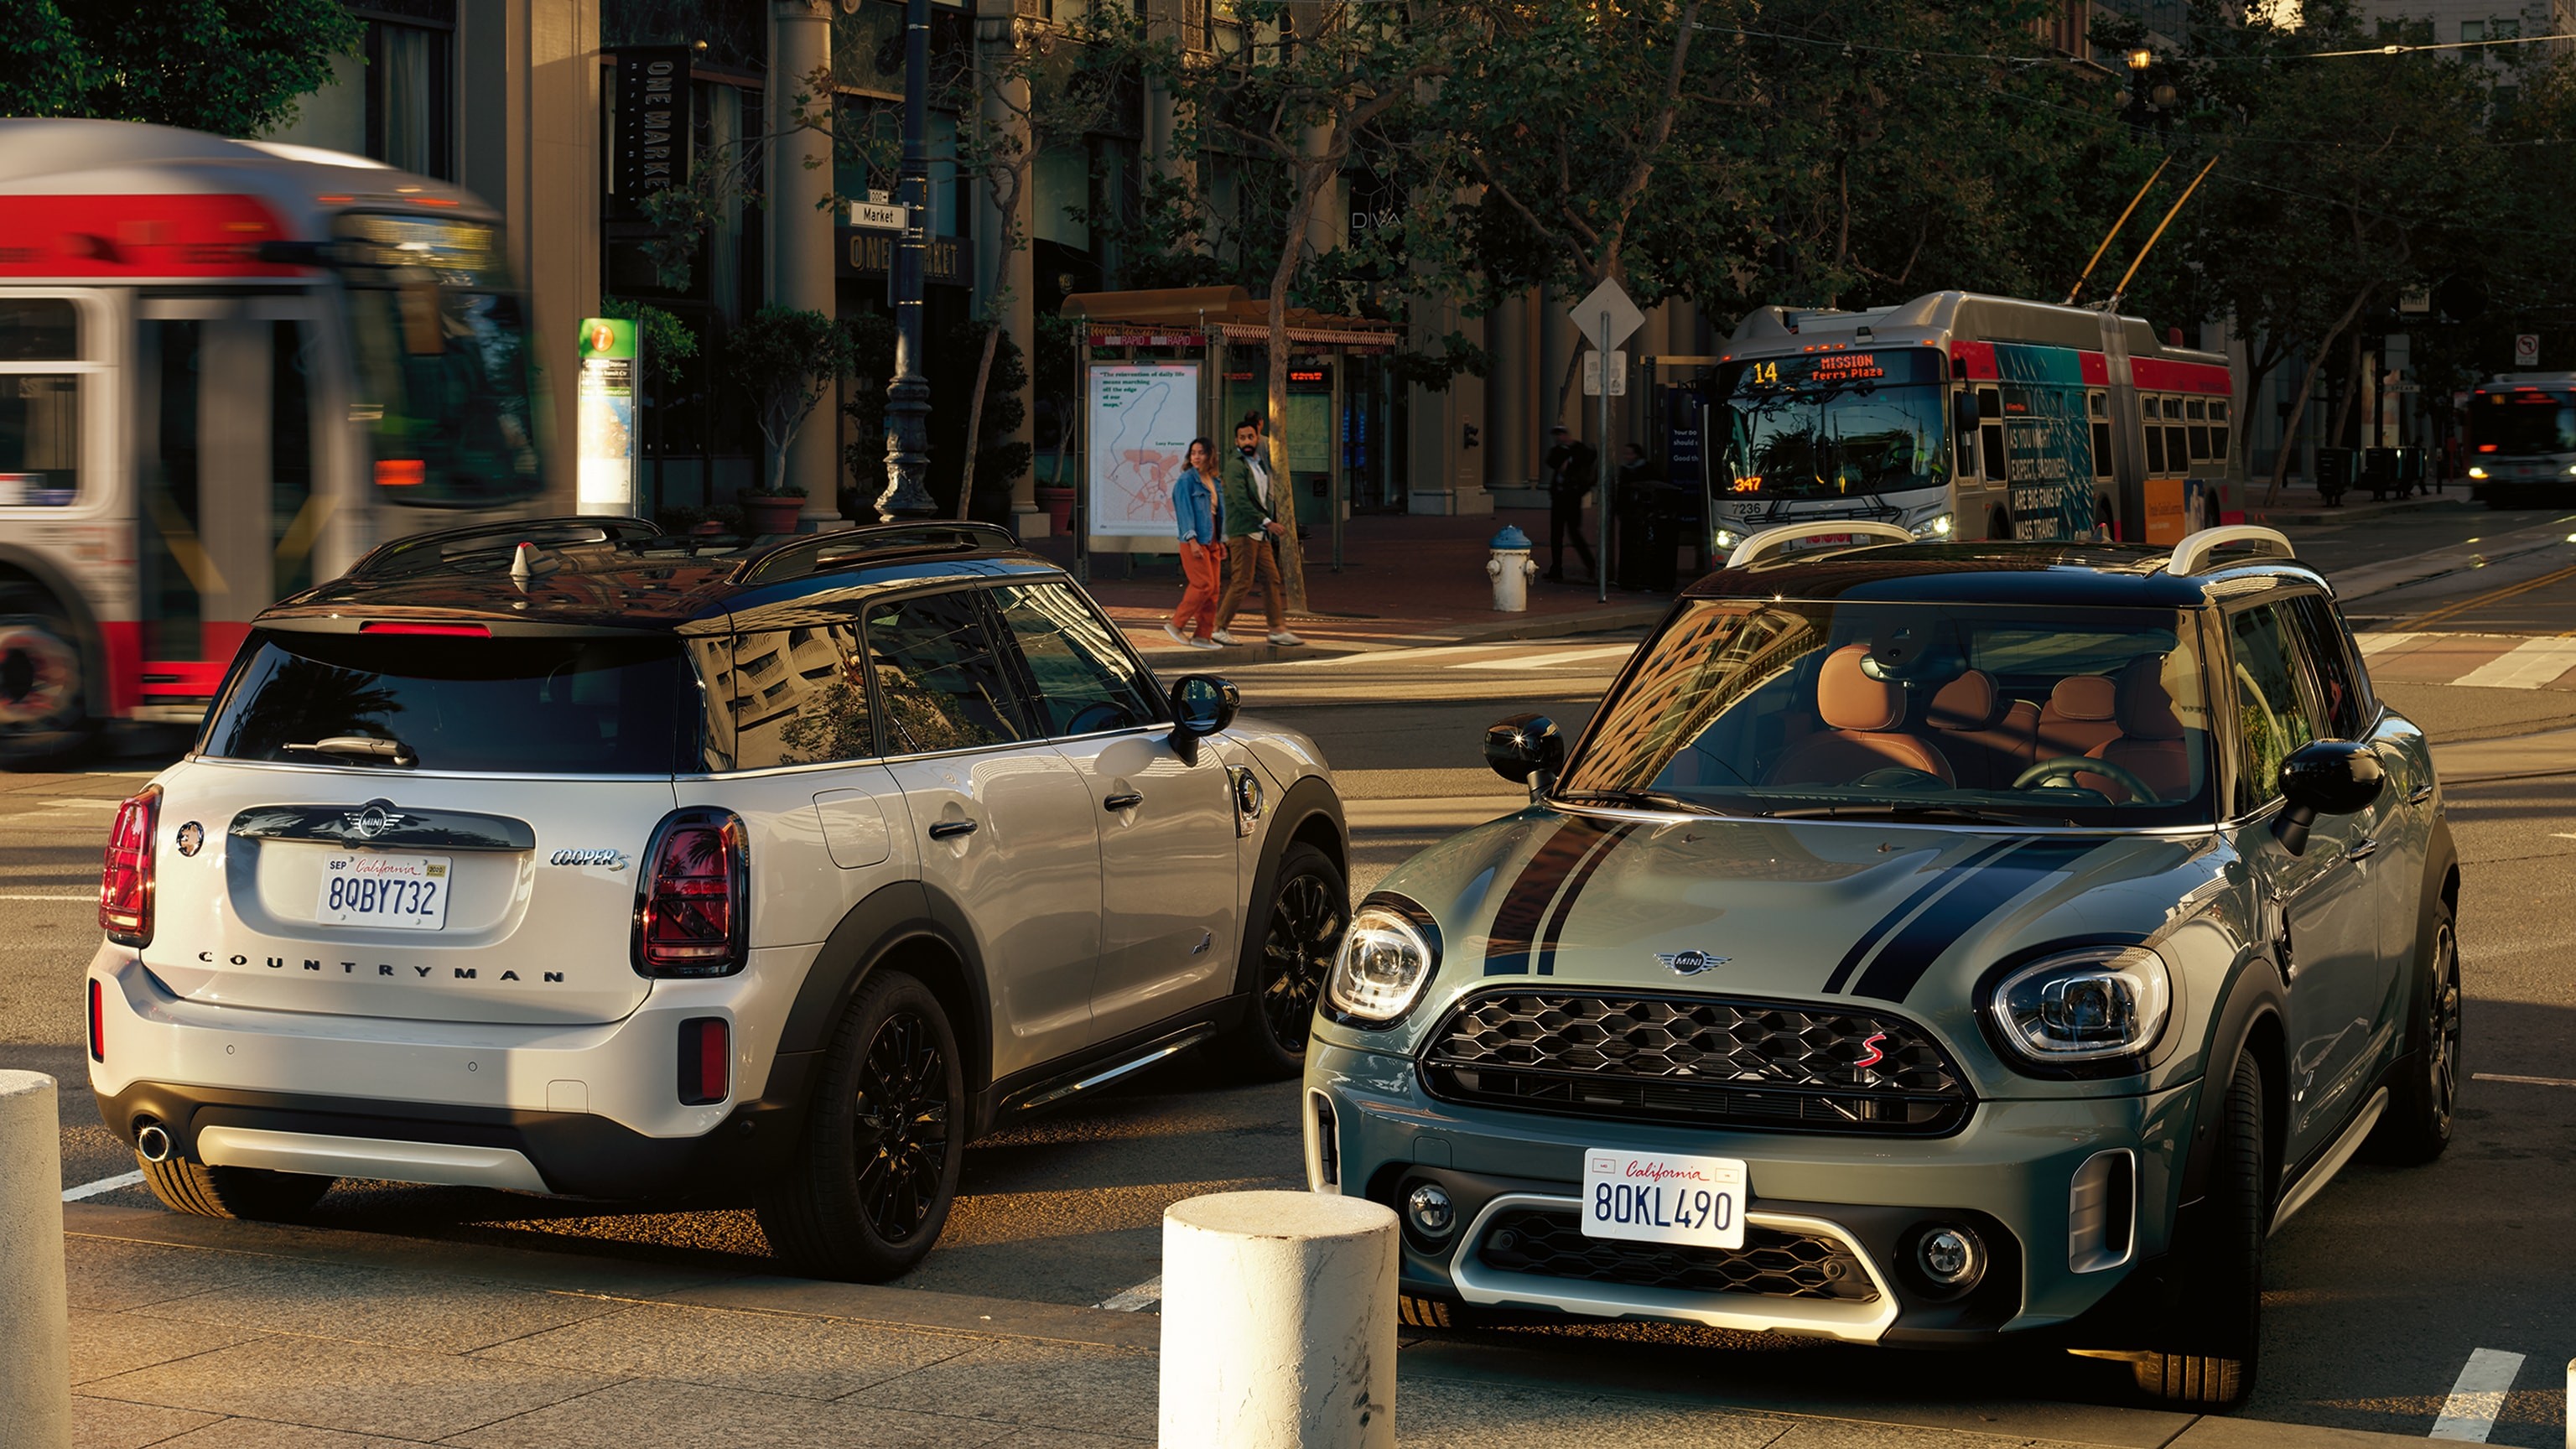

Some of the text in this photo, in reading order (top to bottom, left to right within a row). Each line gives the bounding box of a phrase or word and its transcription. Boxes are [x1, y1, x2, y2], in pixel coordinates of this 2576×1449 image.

[643, 60, 674, 190] ONE MARKE
[864, 207, 894, 224] Market
[849, 234, 958, 279] ONE RKET
[1122, 335, 1145, 345] RAPID
[1167, 336, 1191, 345] RAPID
[1306, 345, 1327, 354] RAPID
[1820, 354, 1874, 370] MISSION
[1753, 361, 1778, 384] 14
[1811, 367, 1884, 382] Ferry Plaza
[2009, 428, 2051, 449] AS YOU MIGHT
[1734, 476, 1763, 493] 347
[2014, 486, 2062, 511] ARE BIG FANS OF
[1732, 502, 1762, 515] 7236
[2015, 519, 2033, 540] MASS
[2033, 517, 2059, 540] TRANSIT
[361, 817, 383, 827] MINI
[550, 848, 617, 866] COOPER
[330, 858, 421, 877] SEP California
[329, 876, 436, 915] 8QBY732
[199, 950, 564, 983] COUNTRYMAN
[1675, 957, 1703, 967] MINI
[1853, 1032, 1887, 1067] S
[1626, 1160, 1710, 1182] California
